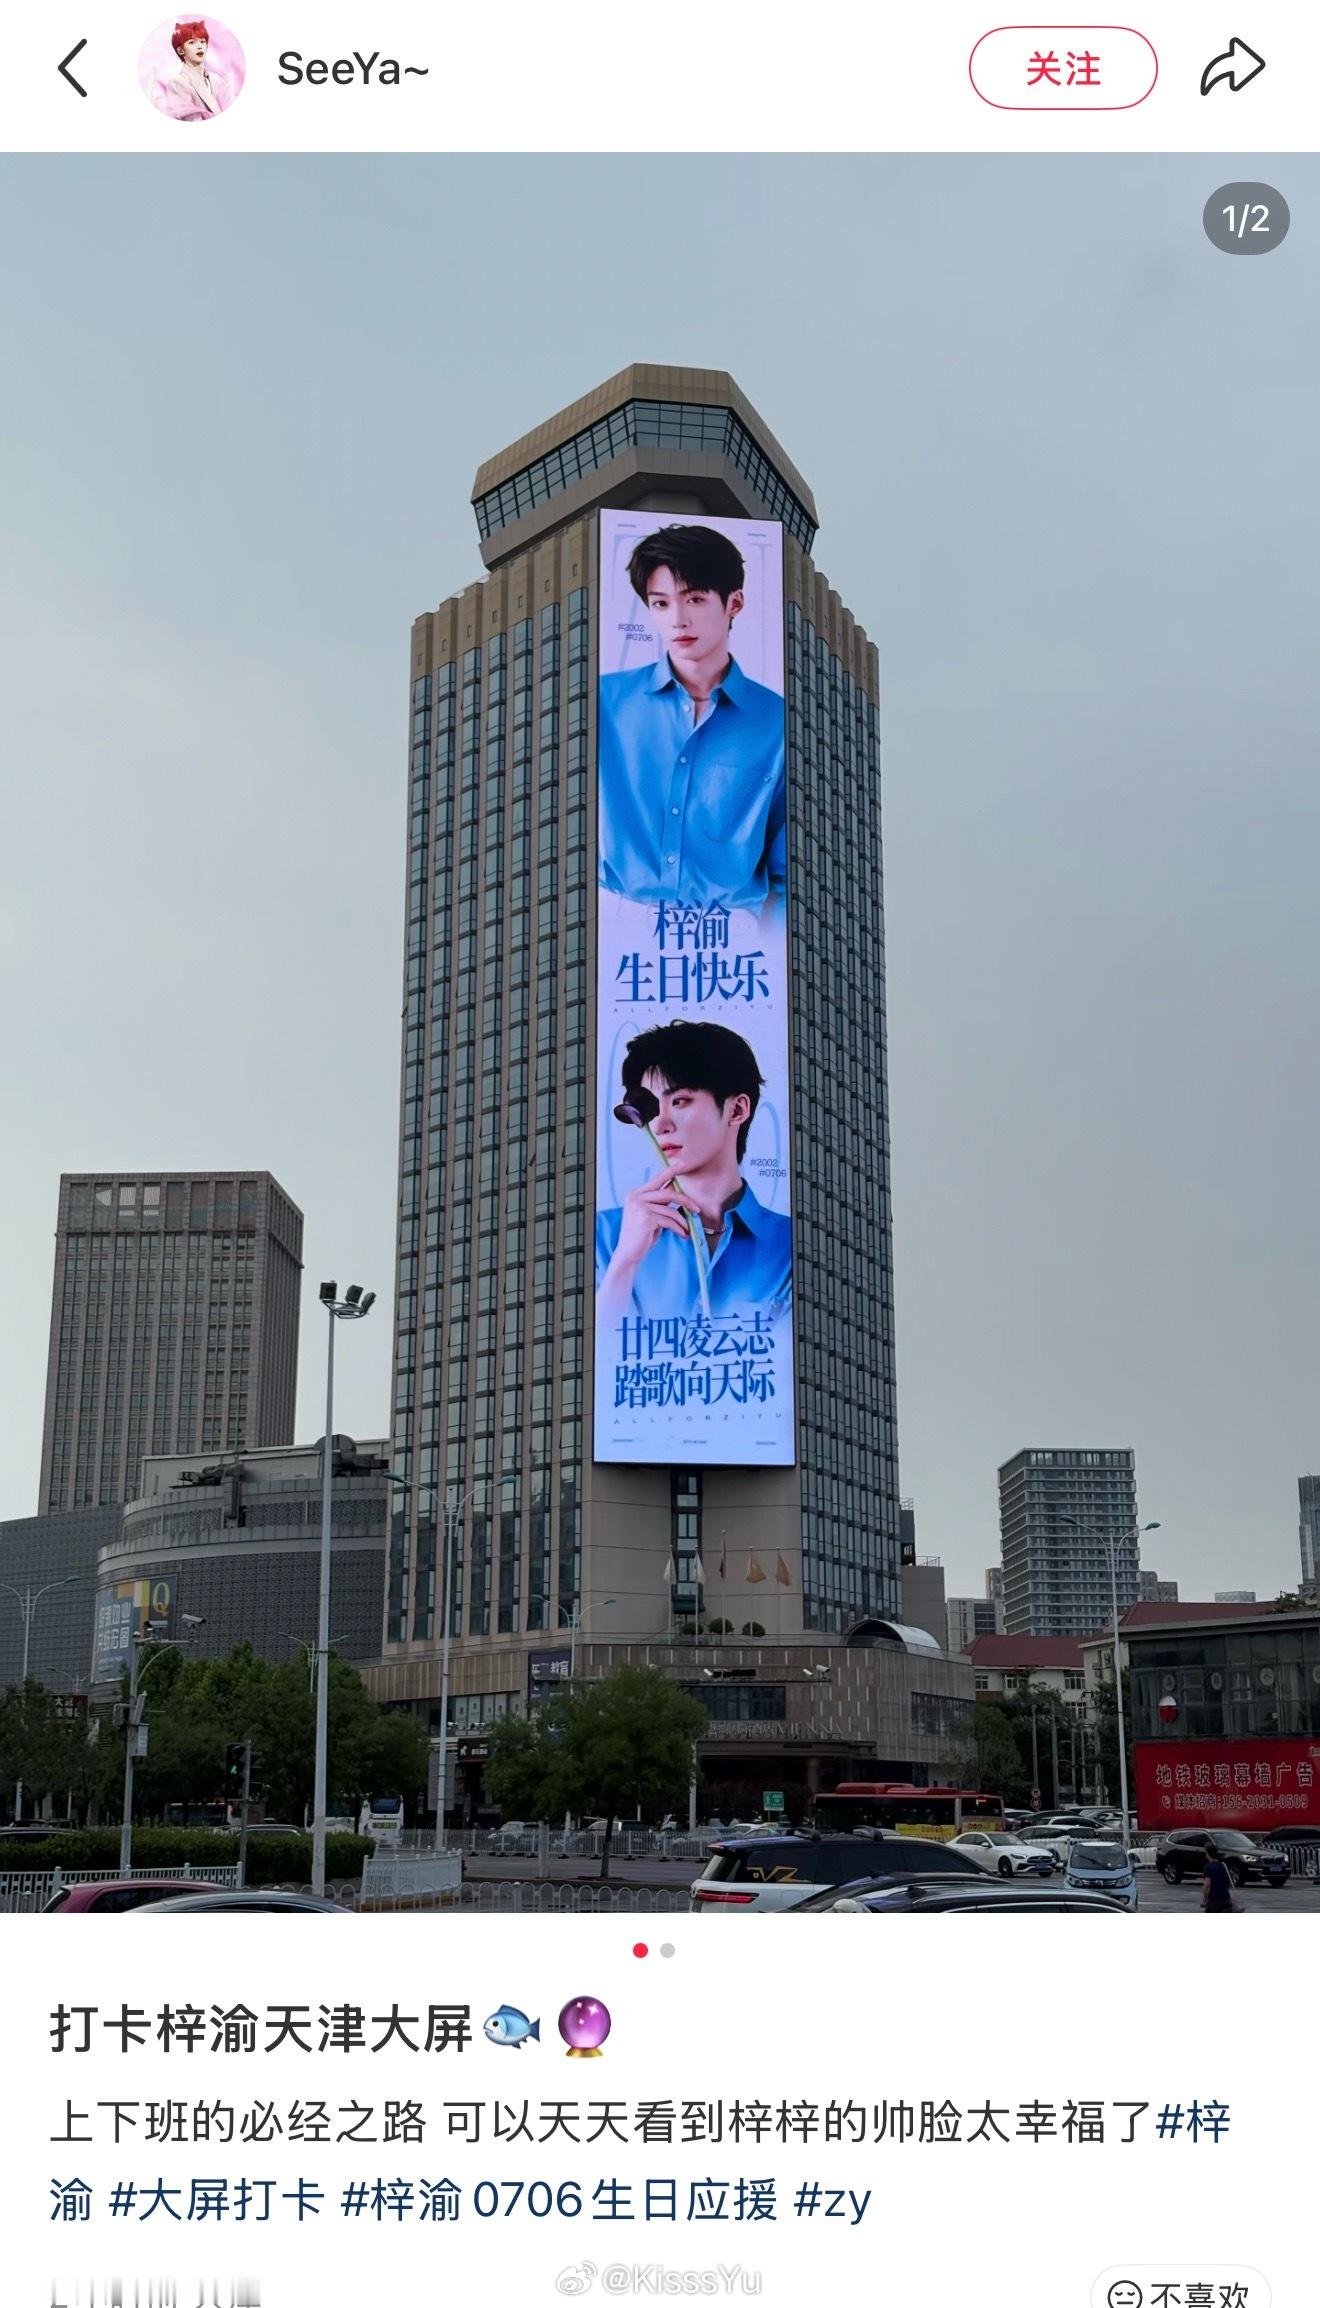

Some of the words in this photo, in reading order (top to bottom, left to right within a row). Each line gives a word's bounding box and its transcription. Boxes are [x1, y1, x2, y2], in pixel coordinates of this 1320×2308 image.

[653, 899, 732, 950] 梓渝
[615, 950, 770, 1003] 生日快乐
[615, 1311, 776, 1361] 廿四凌云志
[614, 1358, 776, 1408] 踏歌向天际
[152, 1582, 171, 1617] Q
[1156, 1761, 1314, 1788] 地铁玻璃幕墙广告
